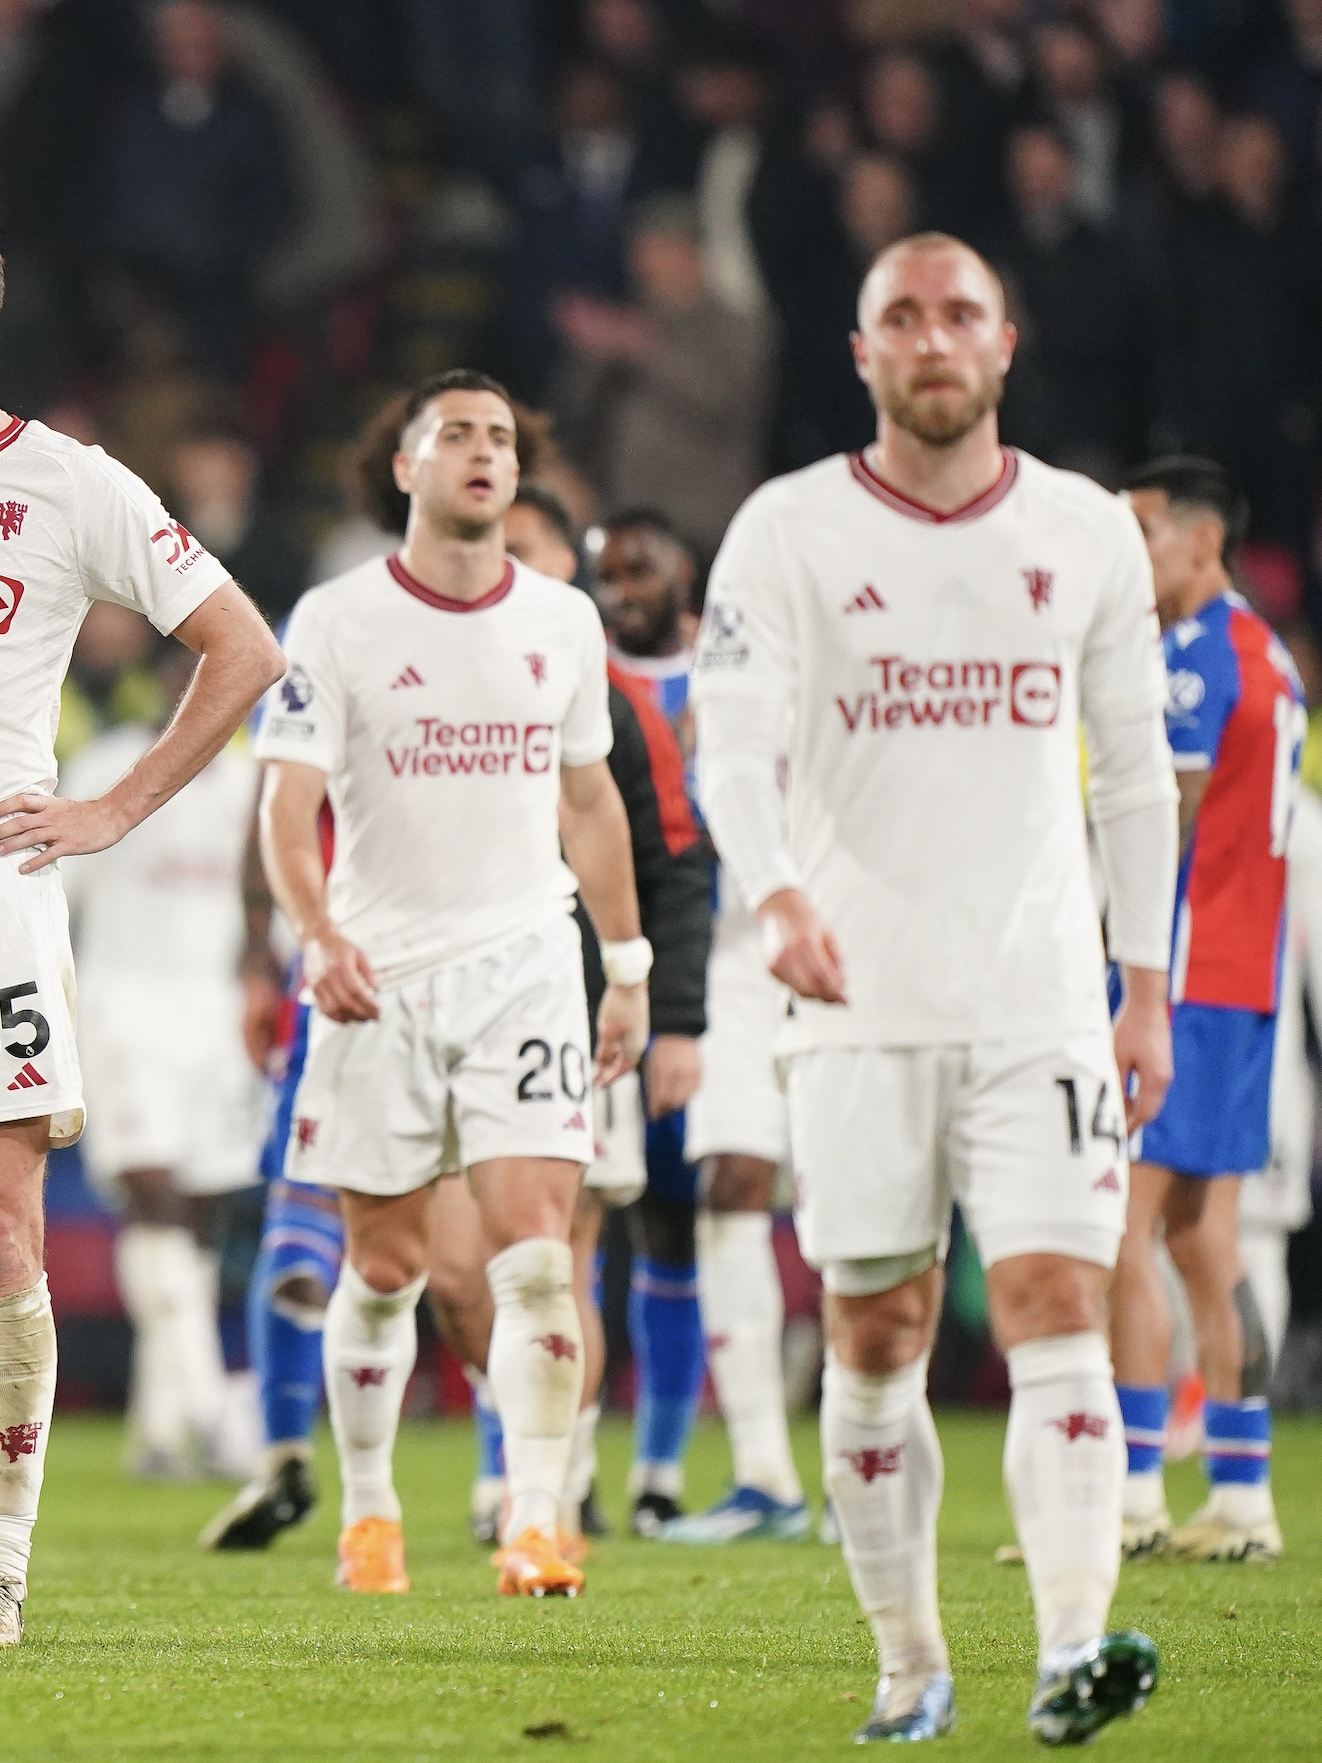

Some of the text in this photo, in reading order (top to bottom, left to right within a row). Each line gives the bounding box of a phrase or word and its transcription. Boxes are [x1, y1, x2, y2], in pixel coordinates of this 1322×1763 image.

[870, 656, 1002, 693] Team
[837, 693, 1001, 732] Viewer
[415, 717, 518, 747] Team
[386, 746, 517, 777] Viewer
[517, 1038, 587, 1104] 20
[1055, 1077, 1127, 1157] 14
